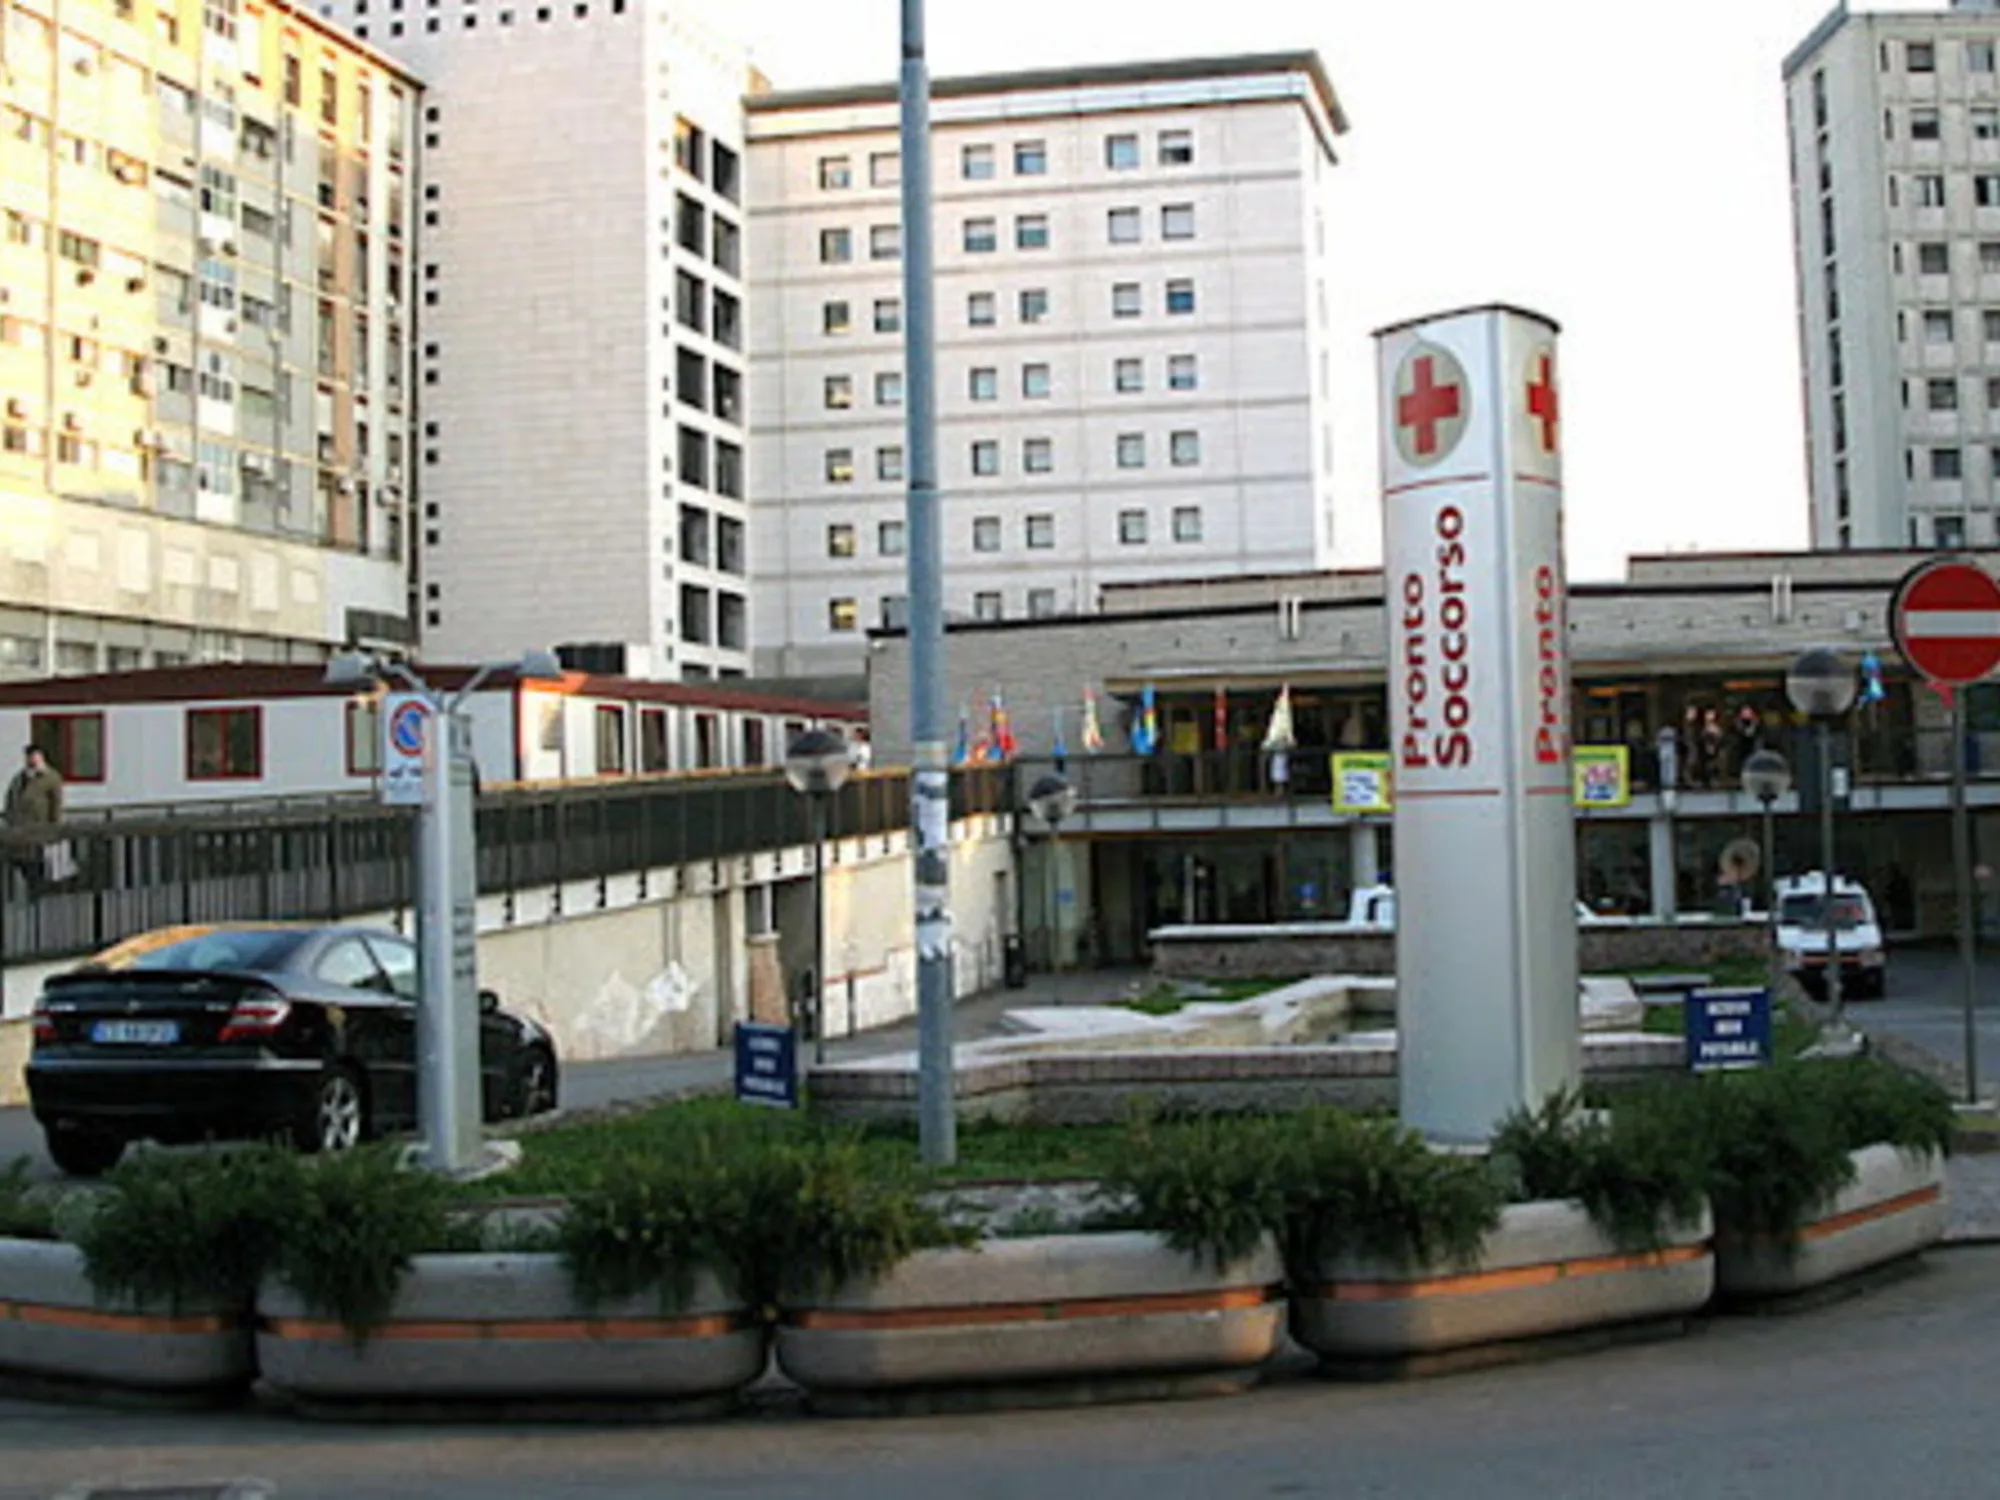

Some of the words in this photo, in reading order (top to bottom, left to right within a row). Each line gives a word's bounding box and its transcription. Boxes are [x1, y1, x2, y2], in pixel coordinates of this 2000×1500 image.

[1403, 573, 1428, 768] Pronto
[1436, 506, 1470, 768] Soccorso
[1535, 565, 1559, 763] Pronto
